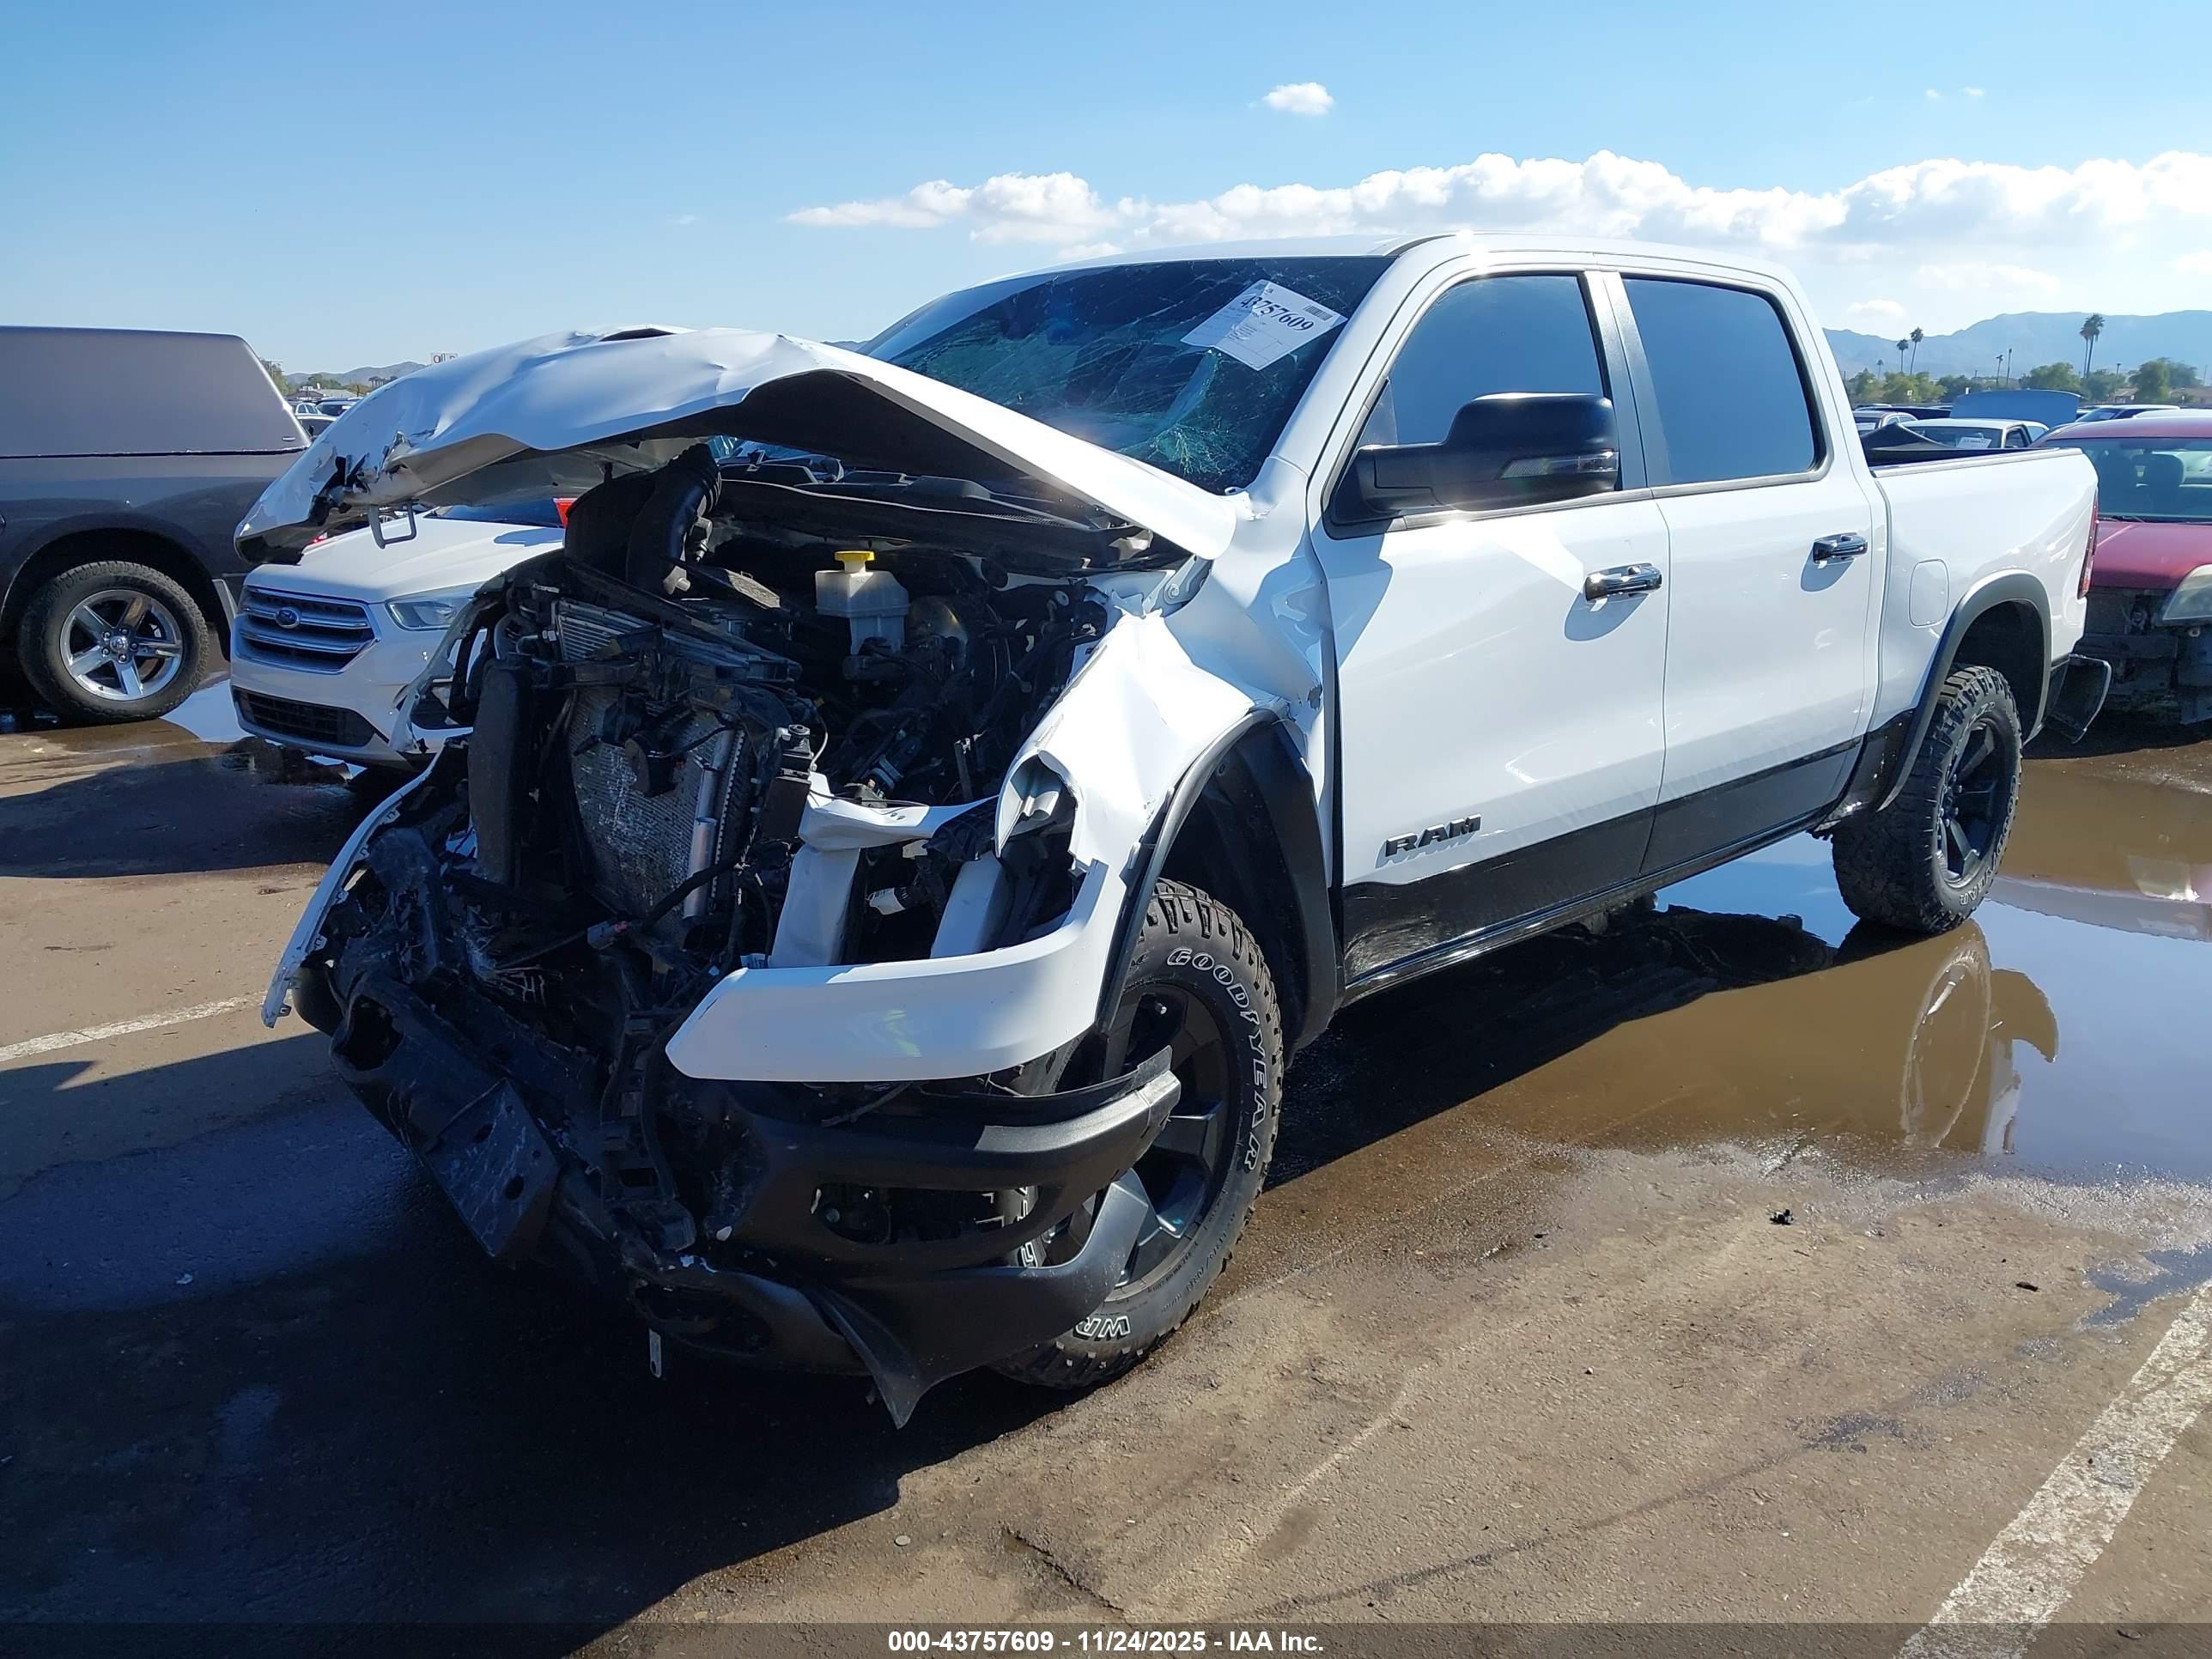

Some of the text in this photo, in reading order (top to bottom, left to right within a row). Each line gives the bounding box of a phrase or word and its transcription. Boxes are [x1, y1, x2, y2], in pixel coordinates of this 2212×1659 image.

[1240, 295, 1315, 331] 43757609
[1384, 812, 1482, 858] RAM
[1166, 946, 1270, 1173] GOODYEAR
